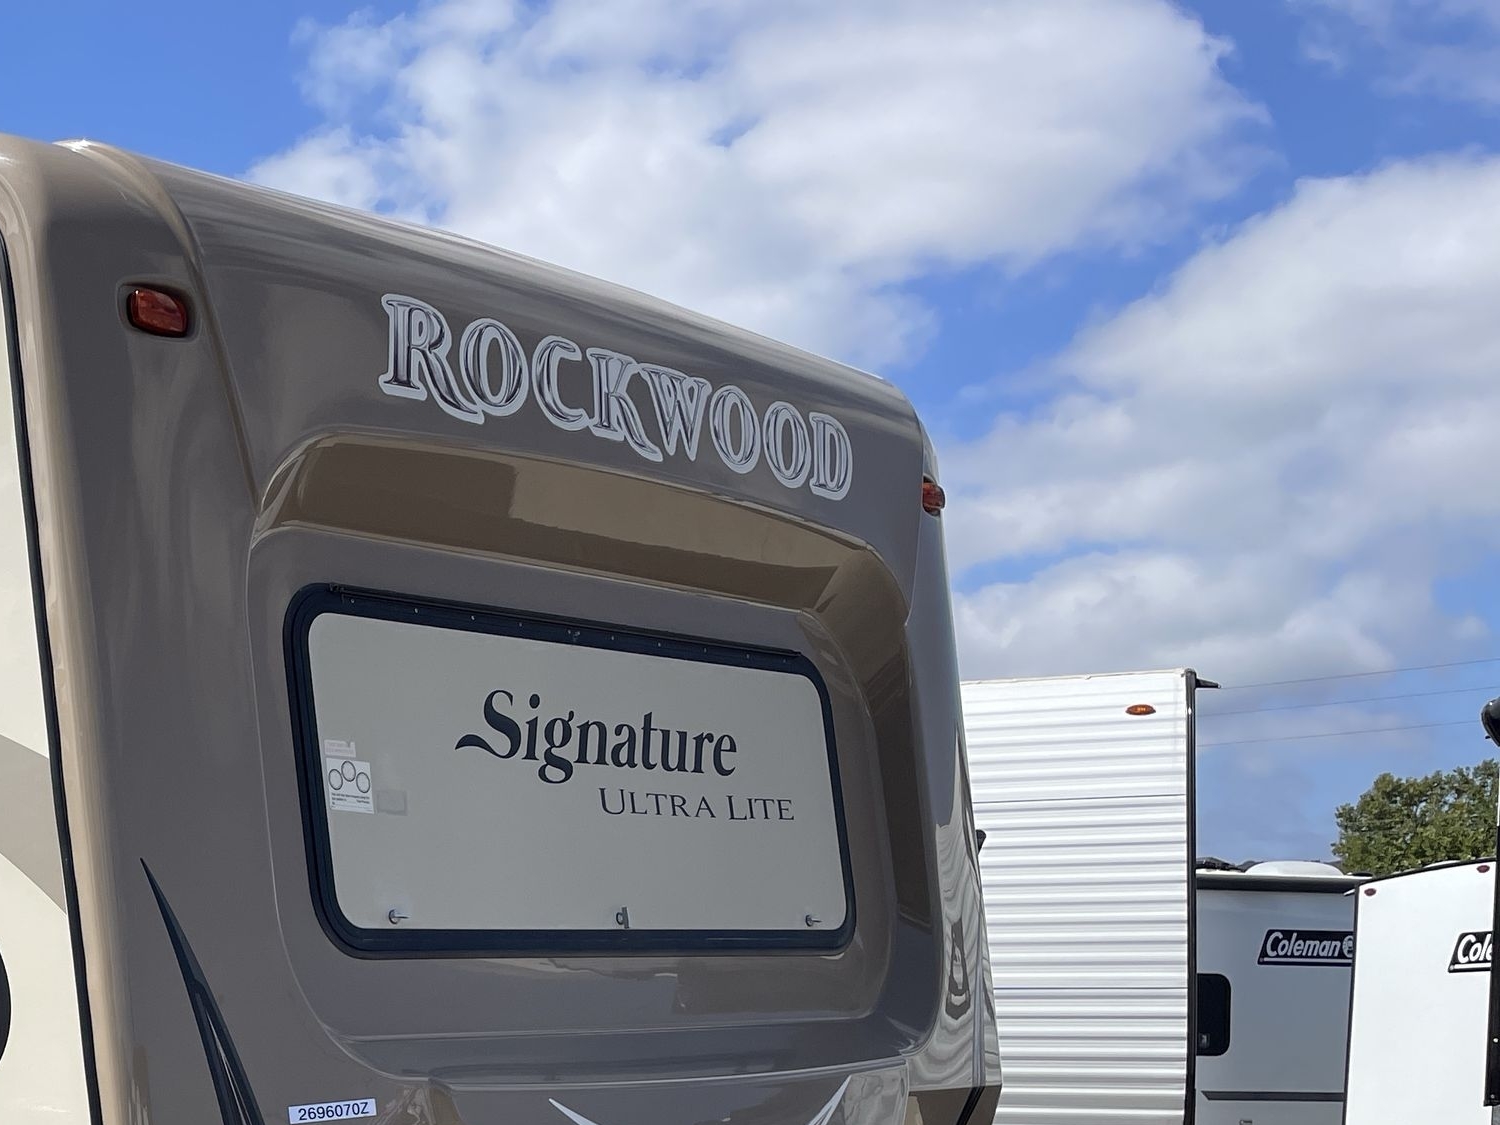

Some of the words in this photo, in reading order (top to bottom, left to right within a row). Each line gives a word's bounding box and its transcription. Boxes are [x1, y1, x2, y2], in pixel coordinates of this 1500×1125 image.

[380, 294, 853, 499] ROCKWOOD
[454, 689, 737, 784] Signature
[598, 787, 717, 820] ULTRA
[725, 795, 795, 821] LITE
[1266, 932, 1341, 957] Coleman
[298, 1101, 369, 1121] 2696070Z
